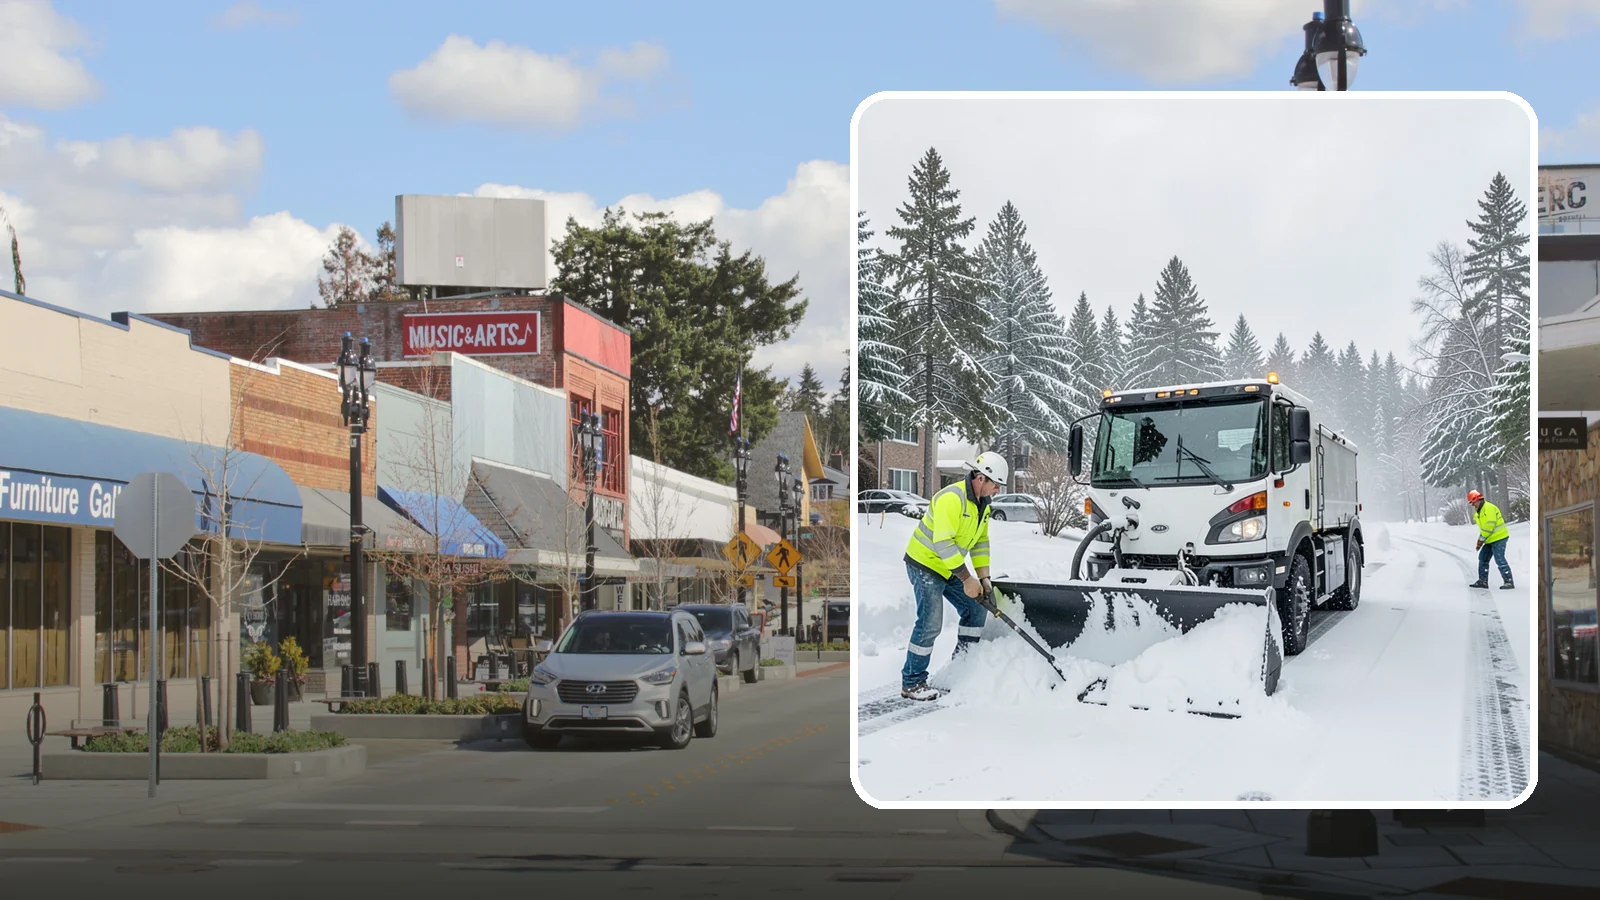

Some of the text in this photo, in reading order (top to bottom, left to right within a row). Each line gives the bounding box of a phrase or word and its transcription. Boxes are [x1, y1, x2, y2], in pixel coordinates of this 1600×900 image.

[0, 471, 121, 519] Furniture Gal
[453, 563, 479, 574] SUSHI
